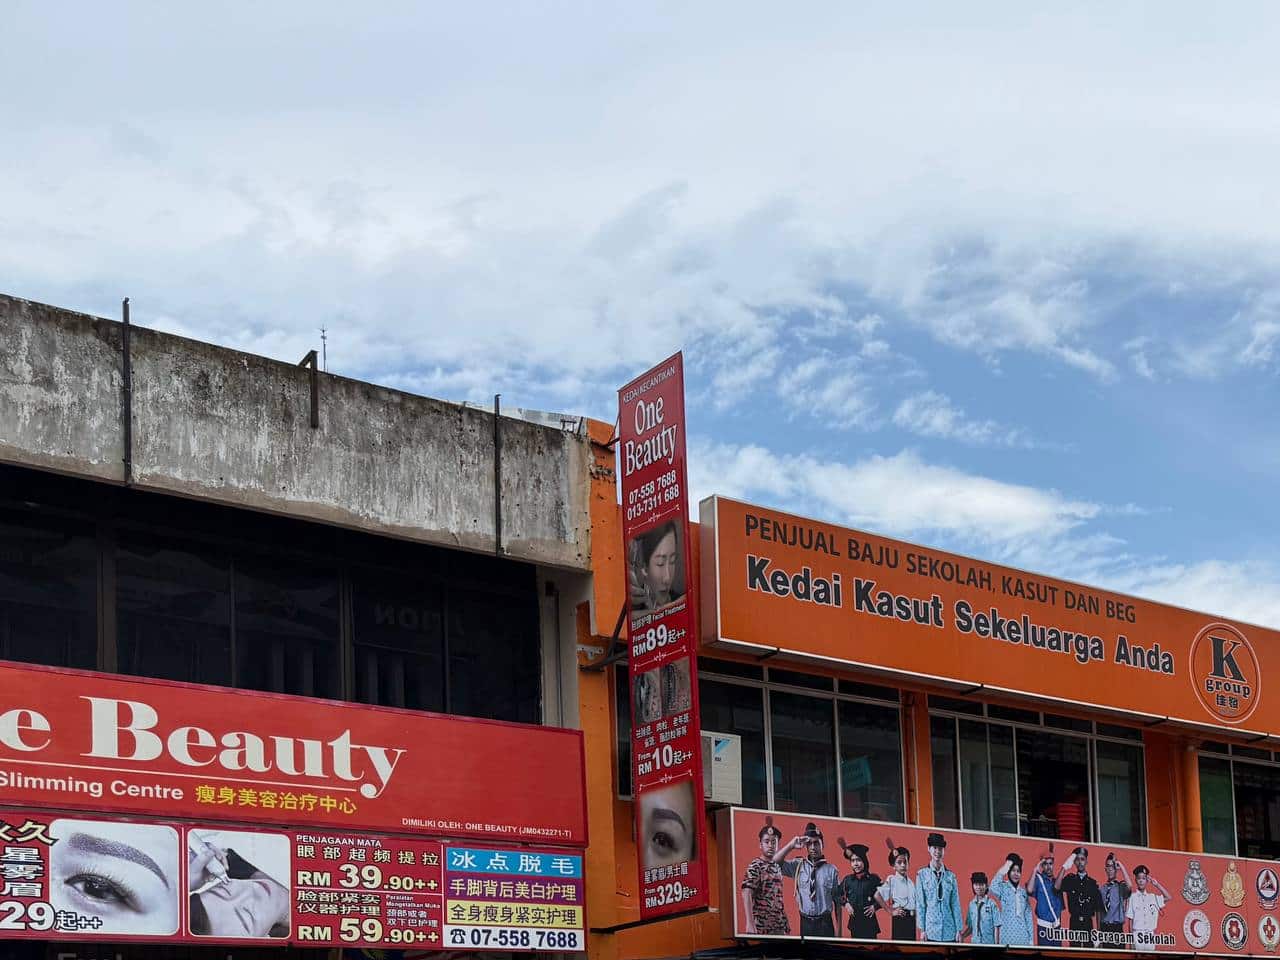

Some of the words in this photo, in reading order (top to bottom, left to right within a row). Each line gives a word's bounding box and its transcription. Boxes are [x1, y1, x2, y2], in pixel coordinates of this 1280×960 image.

[634, 396, 664, 436] One
[625, 423, 677, 476] Beauty
[629, 481, 655, 505] 07-558
[657, 470, 677, 491] 7688
[627, 493, 662, 521] 013-7311
[664, 484, 679, 502] 688
[745, 514, 840, 556] PENJUAL
[847, 540, 900, 569] BAJU
[906, 553, 997, 593] SEKOLAH,
[1001, 575, 1058, 606] KASUT
[1064, 590, 1100, 616] DAN
[1106, 599, 1136, 623] BEG
[746, 554, 842, 608] Kedai
[853, 577, 943, 628] Kasut
[954, 599, 1105, 664] Sekeluarga
[1113, 635, 1175, 676] Anda
[1207, 635, 1247, 683] K
[1205, 678, 1251, 699] group
[79, 695, 407, 798] Beauty
[0, 771, 103, 798] Slimming
[111, 780, 184, 800] Centre
[195, 784, 357, 814] 瘦身美容治疗中心
[402, 818, 436, 828] DIMILIKI
[437, 820, 463, 830] OLEH:
[465, 822, 483, 831] ONE
[485, 824, 518, 834] BEAUTY
[296, 834, 354, 846] PENJAGAAN
[357, 839, 382, 847] MATA
[297, 844, 439, 866] 眼部超频提拉
[452, 851, 575, 875] 冰点脱毛
[297, 870, 331, 887] RM
[450, 878, 577, 901] 手脚背后美白护理
[450, 904, 577, 926] 全身瘦身紧实护理
[297, 925, 332, 941] RM
[470, 928, 530, 946] 07-558
[535, 930, 578, 948] 7688
[1046, 927, 1090, 942] Uniform
[1091, 929, 1135, 944] Seragam
[1137, 931, 1176, 945] Sekolah
